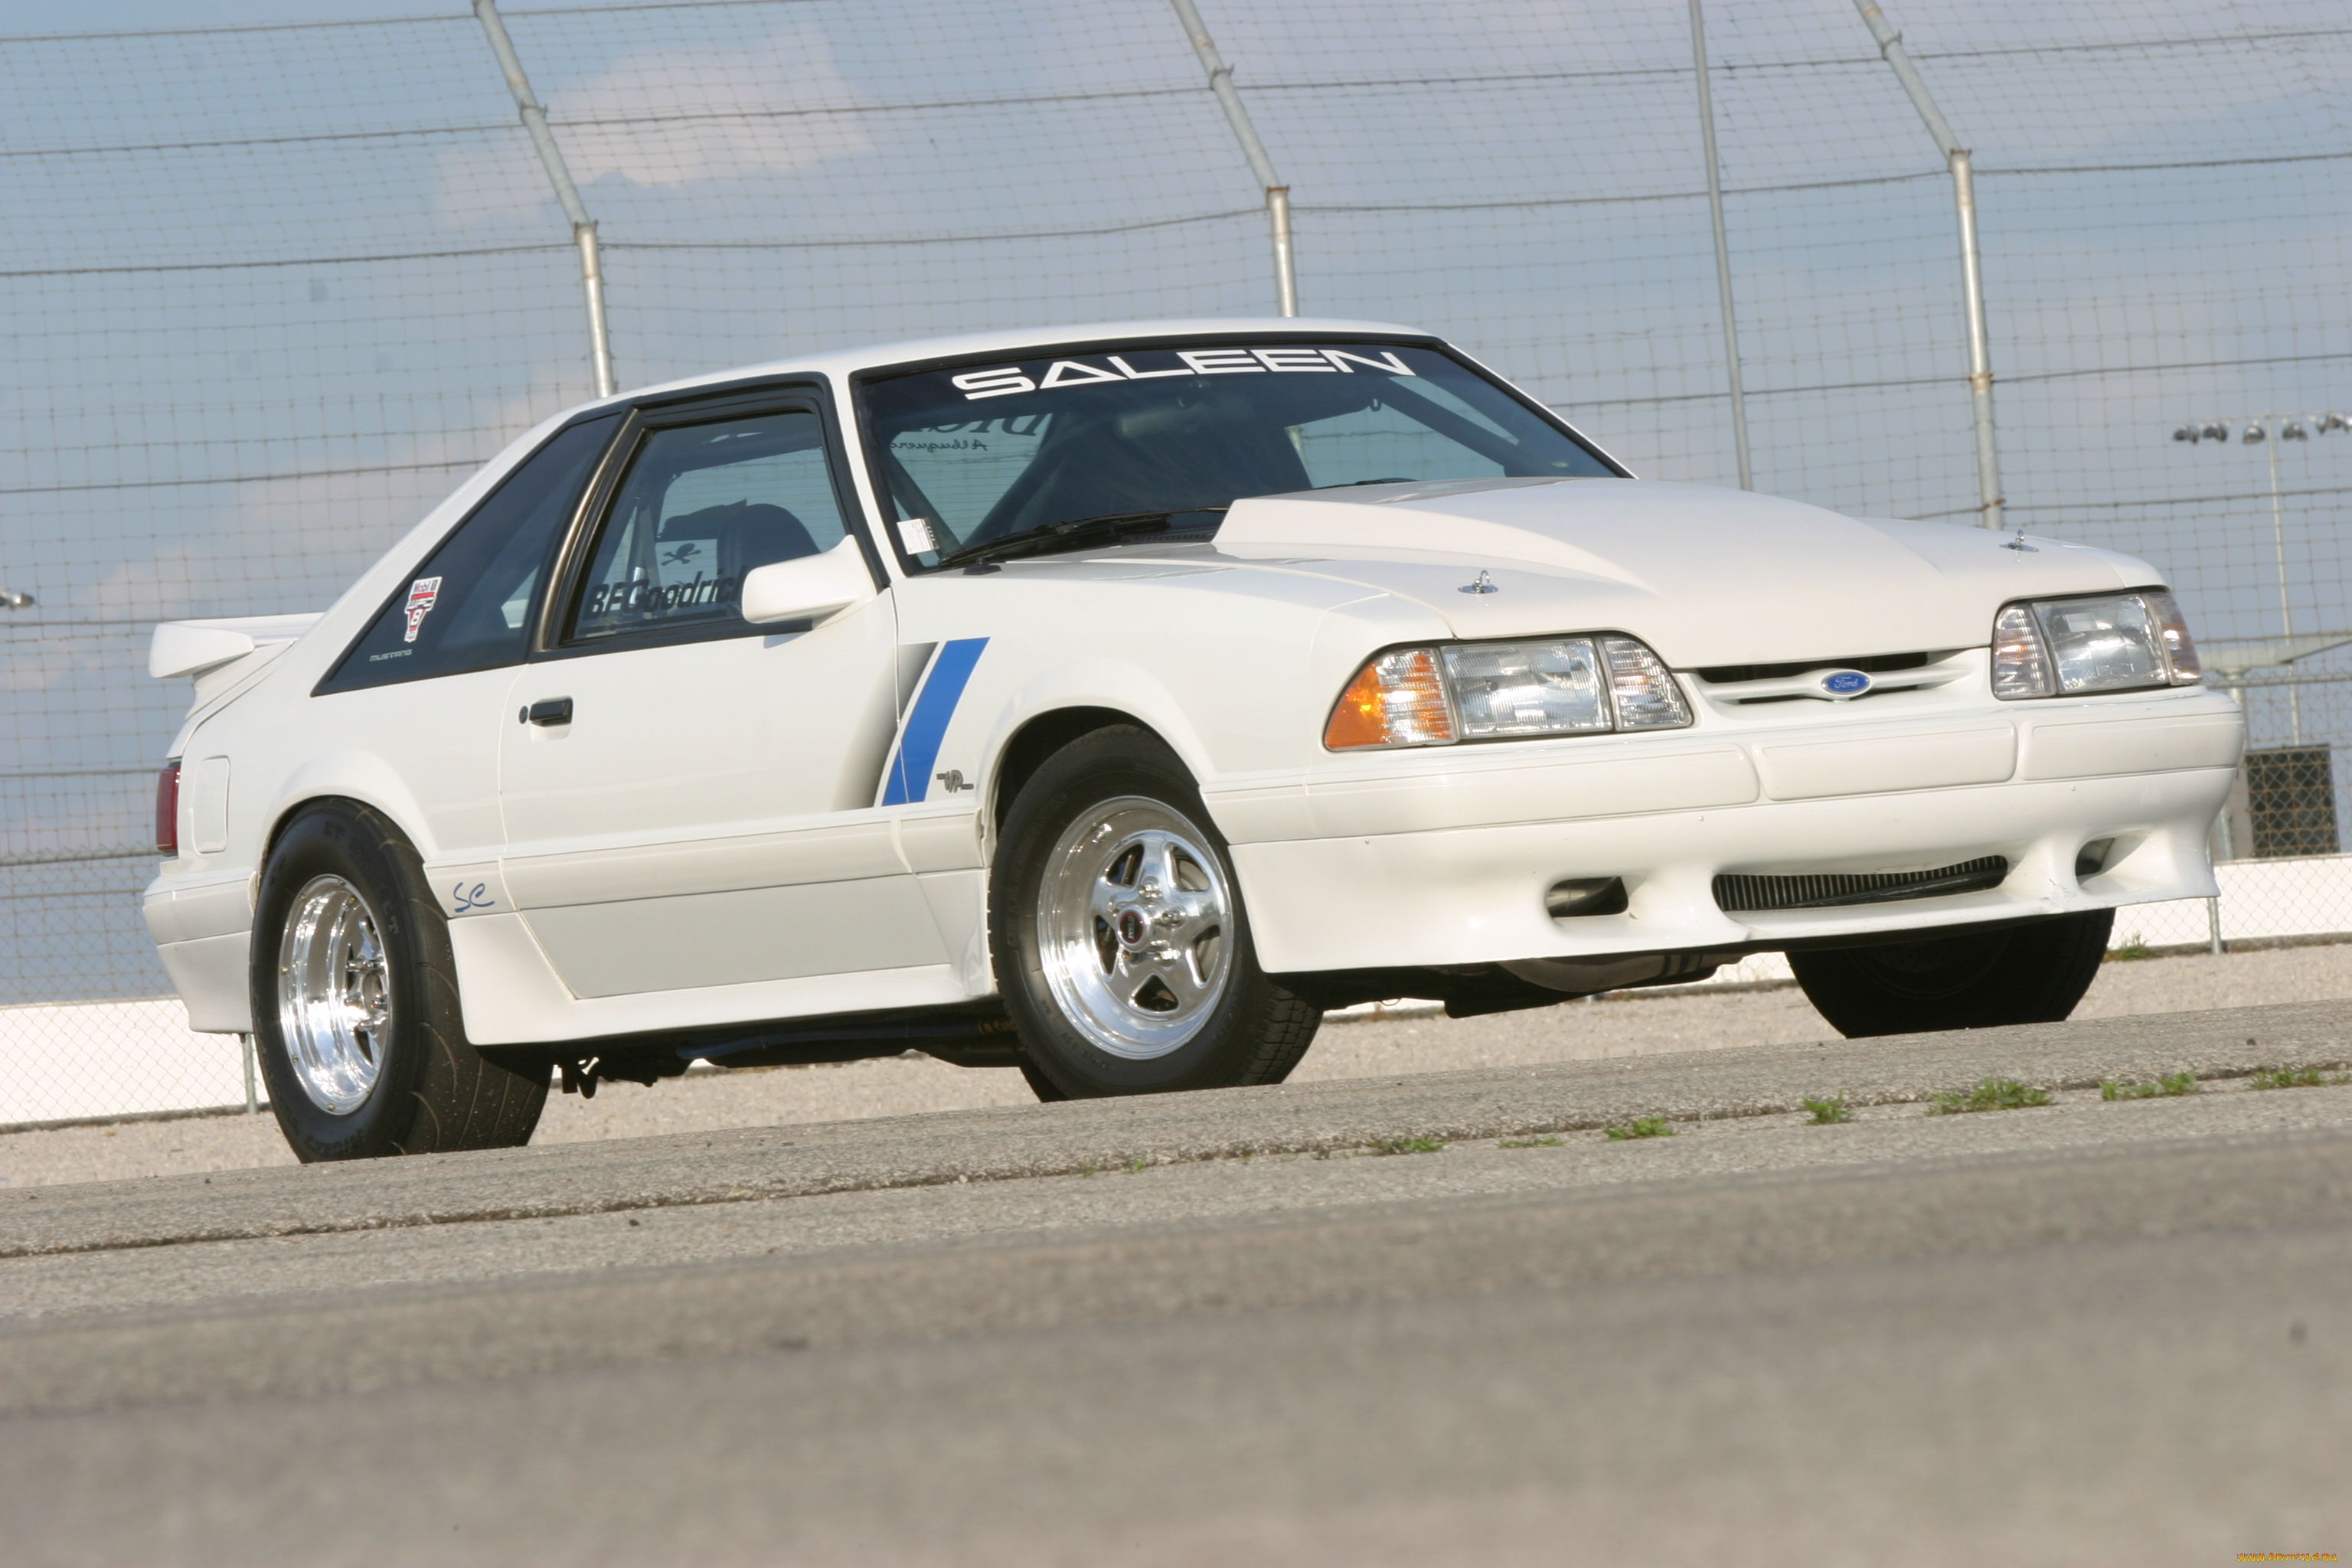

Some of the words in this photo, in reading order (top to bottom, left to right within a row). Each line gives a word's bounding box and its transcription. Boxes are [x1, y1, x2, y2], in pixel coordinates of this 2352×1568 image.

[952, 349, 1416, 400] SALEEN
[370, 649, 412, 662] MUSTANG
[1834, 676, 1859, 688] Ford
[1127, 915, 1135, 940] WELD
